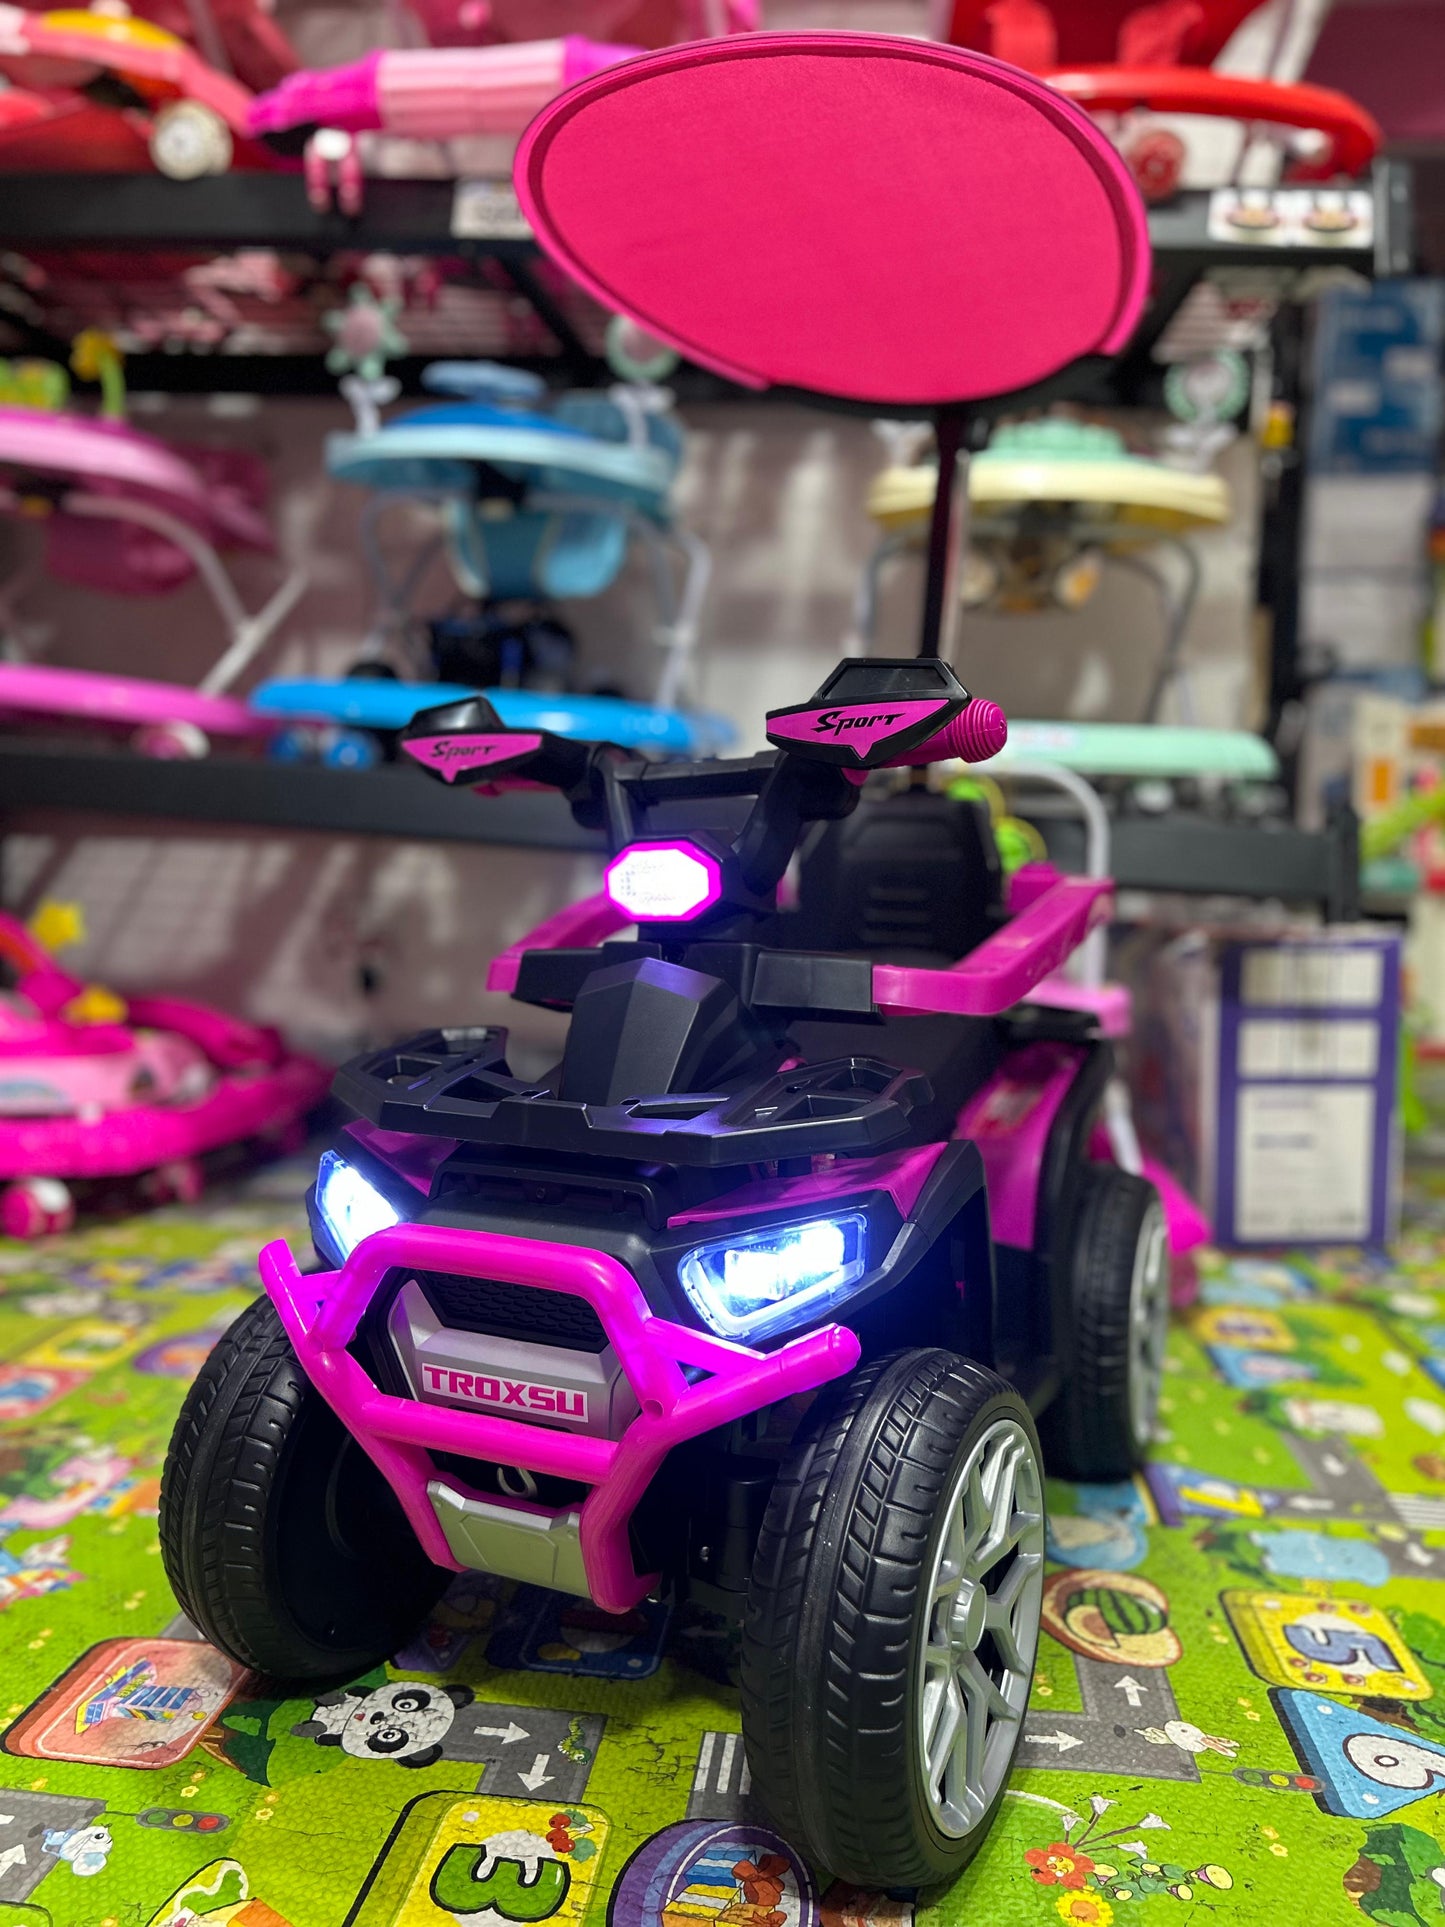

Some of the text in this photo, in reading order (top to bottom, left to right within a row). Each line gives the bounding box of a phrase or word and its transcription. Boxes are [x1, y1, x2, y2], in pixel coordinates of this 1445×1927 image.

[811, 710, 906, 736] Sport
[424, 1366, 585, 1417] TROXSU
[1282, 1624, 1405, 1674] 5
[429, 1843, 571, 1923] 3
